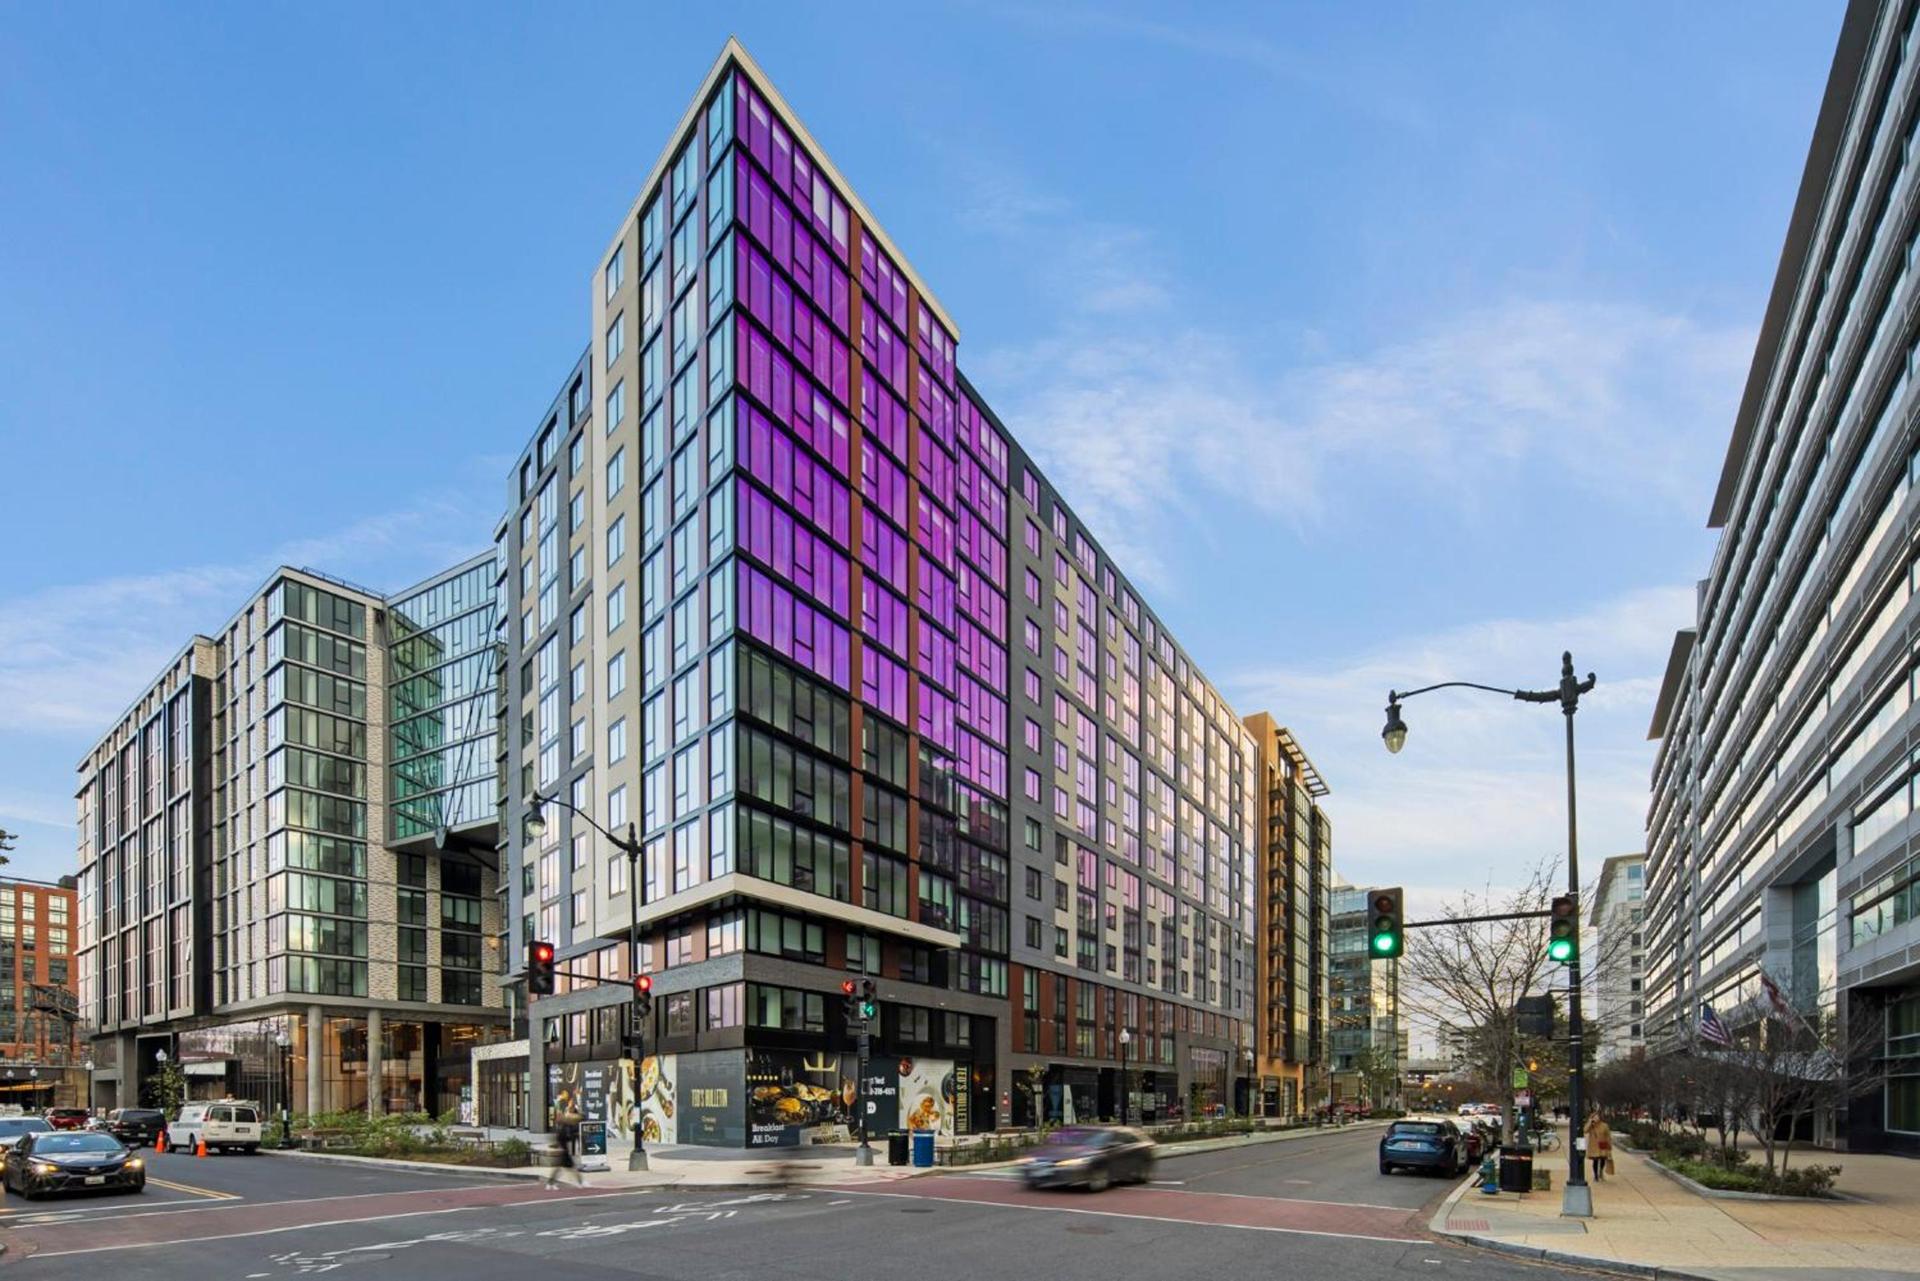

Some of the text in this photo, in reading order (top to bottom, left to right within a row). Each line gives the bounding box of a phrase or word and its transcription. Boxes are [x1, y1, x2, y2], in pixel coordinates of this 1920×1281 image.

[751, 1123, 785, 1133] Breakfast
[752, 1134, 779, 1144] All Day
